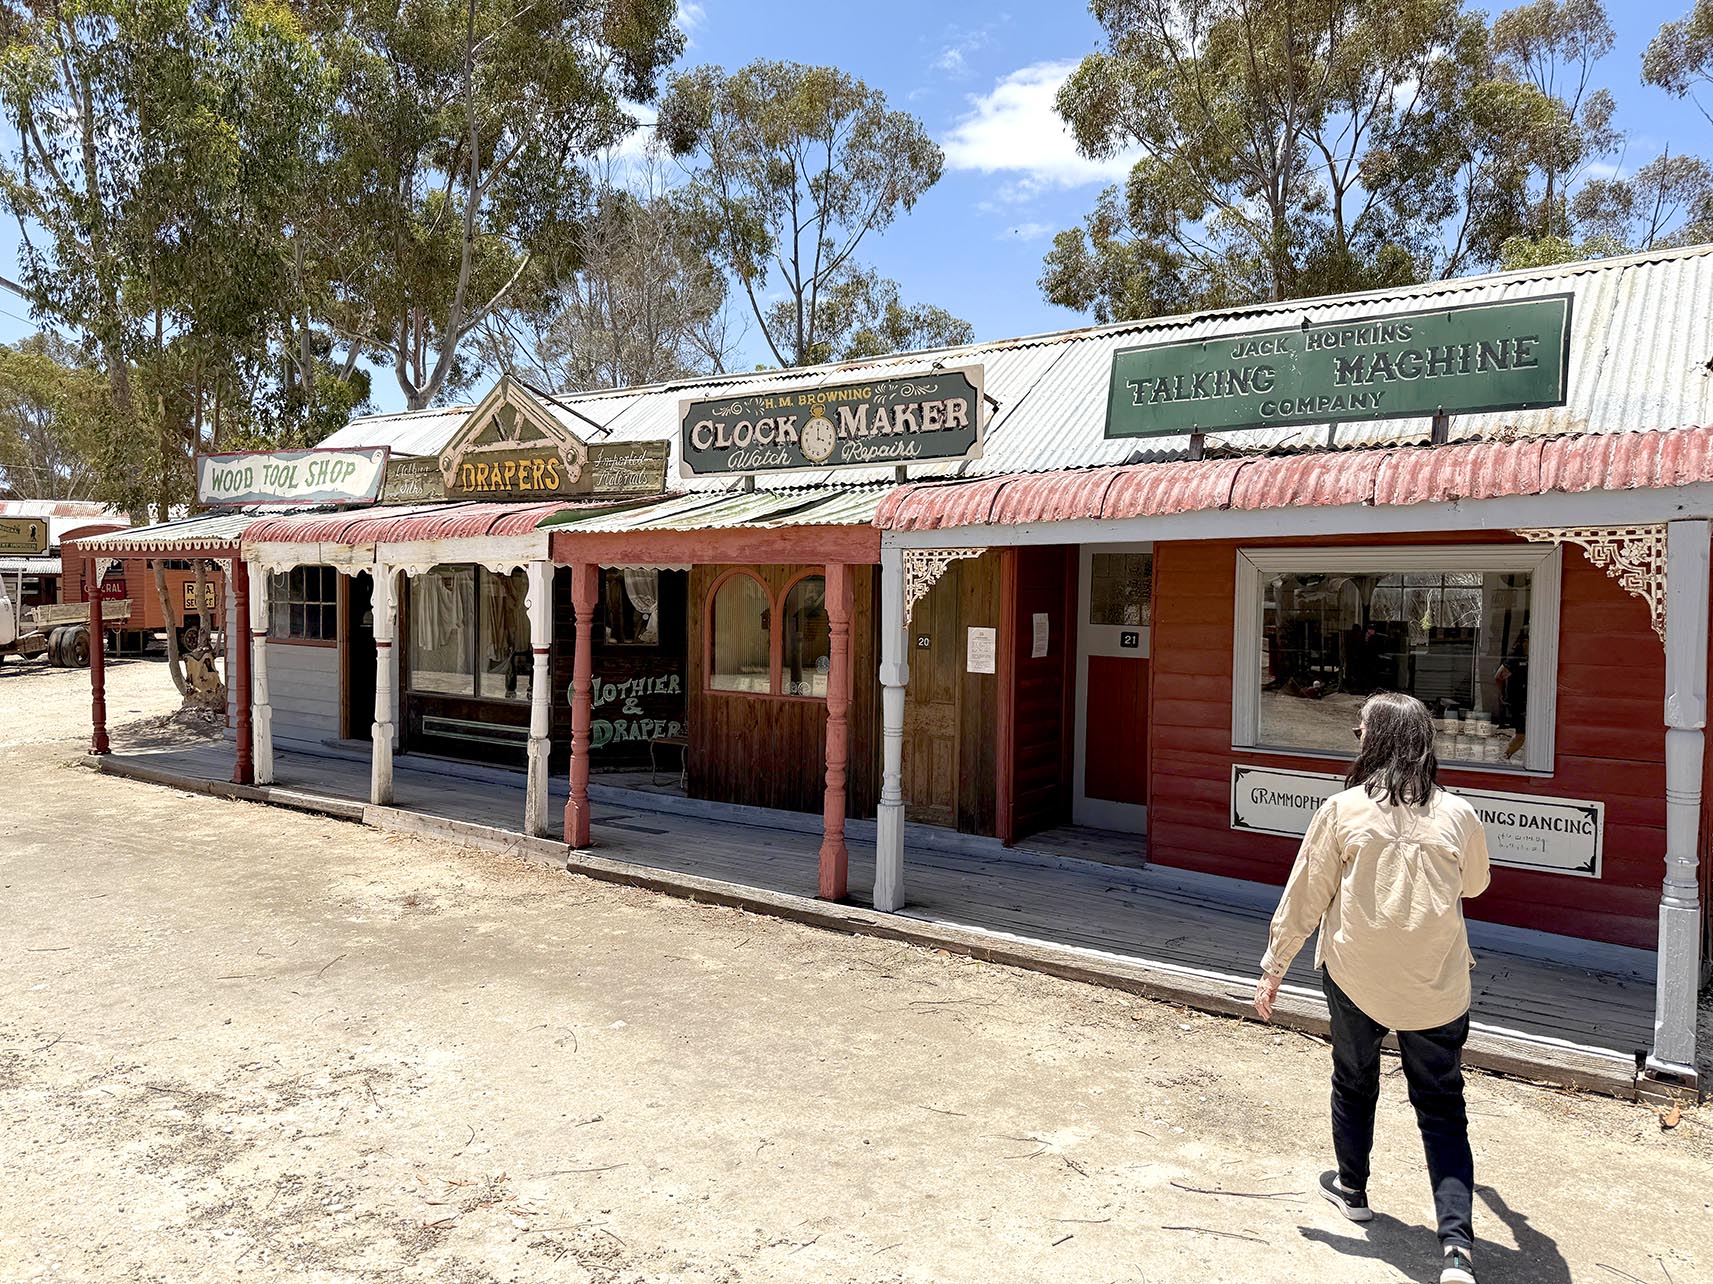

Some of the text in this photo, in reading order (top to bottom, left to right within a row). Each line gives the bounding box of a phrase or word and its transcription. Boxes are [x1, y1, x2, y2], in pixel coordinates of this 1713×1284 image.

[1230, 322, 1413, 360] JACK HOPKINS
[1127, 334, 1540, 407] TALKING MACHINE
[799, 387, 872, 406] BROWNING
[1258, 391, 1386, 418] COMPANY
[690, 415, 799, 453] CLOCK
[836, 397, 970, 441] MAKER
[728, 440, 922, 469] Watch Repairs
[212, 459, 356, 492] WOOD TOOL SHOP
[461, 457, 561, 493] DRAPERS
[918, 637, 930, 646] 20
[1124, 635, 1136, 645] 21
[622, 697, 645, 715] &
[588, 719, 682, 749] DRAPER
[1519, 814, 1592, 836] DANCING
